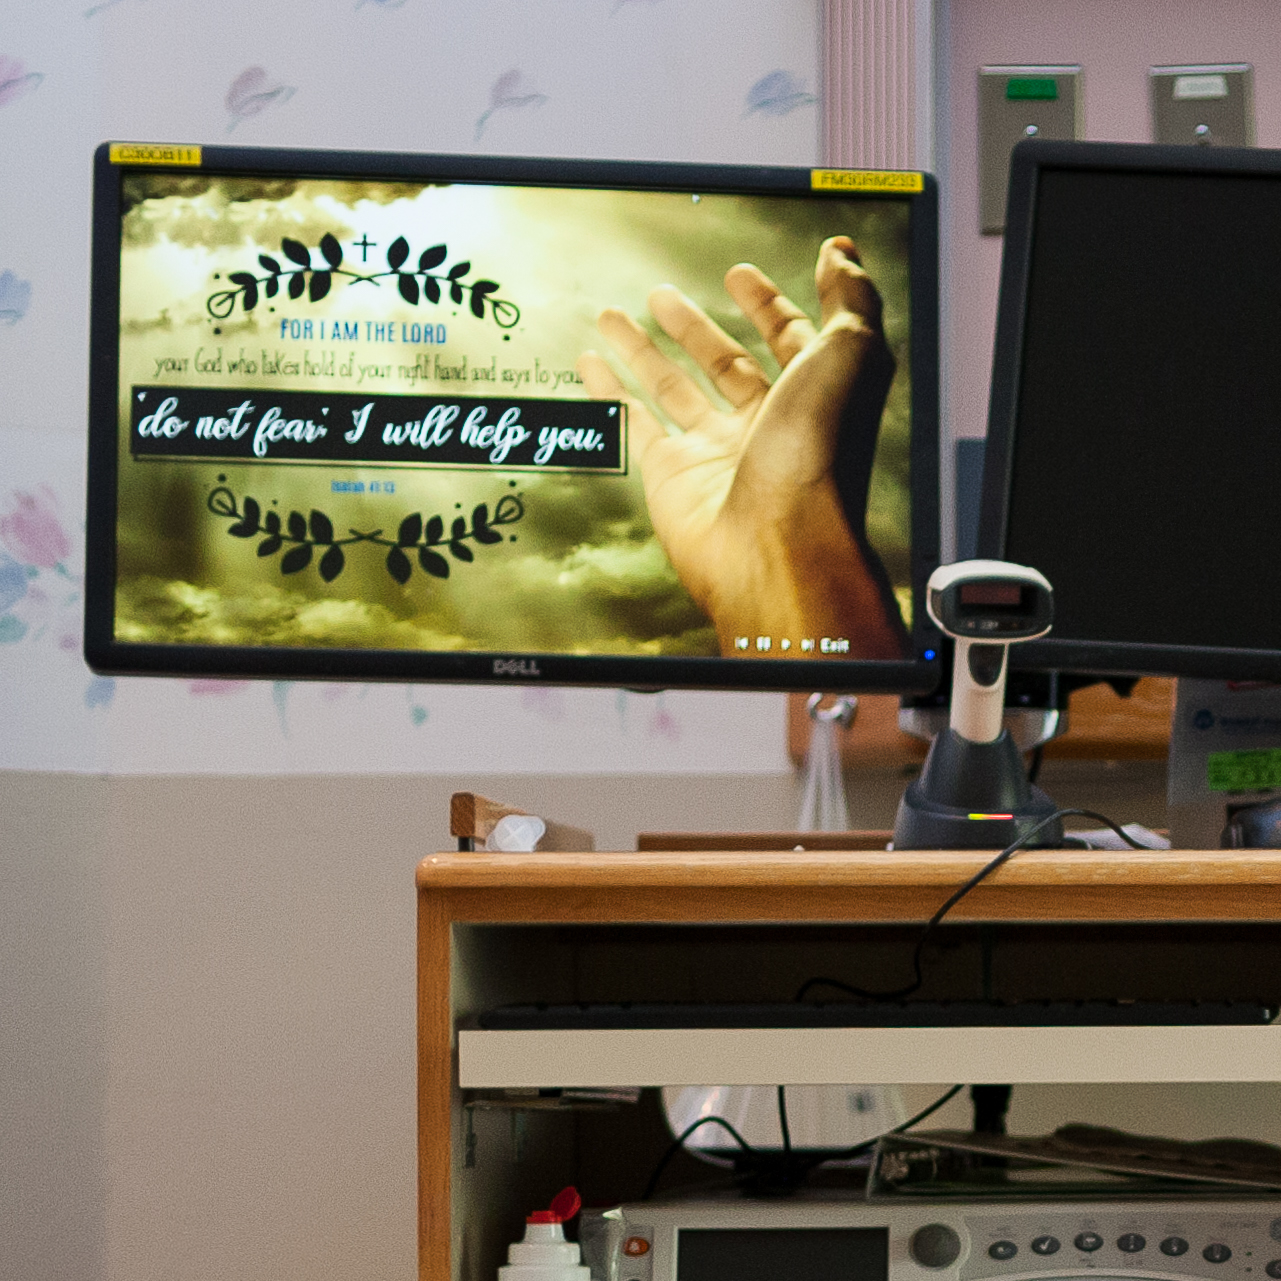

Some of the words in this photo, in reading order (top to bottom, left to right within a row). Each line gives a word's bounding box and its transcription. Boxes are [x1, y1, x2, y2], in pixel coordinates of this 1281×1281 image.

[280, 318, 314, 340] FOR
[320, 320, 325, 340] I
[331, 321, 359, 341] AM
[365, 321, 396, 343] THE
[402, 322, 447, 344] LORD
[152, 355, 189, 378] your
[194, 347, 223, 374] God
[227, 348, 257, 374] who
[303, 350, 335, 377] hold
[339, 351, 354, 377] of
[356, 363, 391, 384] your
[397, 353, 428, 387] right
[433, 353, 468, 381] hand
[471, 355, 496, 382] and
[501, 367, 530, 389] says
[534, 356, 549, 384] to
[195, 399, 256, 441] not
[344, 402, 375, 444] I
[382, 404, 461, 450] will
[460, 405, 532, 464] help
[820, 637, 849, 653] Exit
[493, 660, 540, 675] DELL
